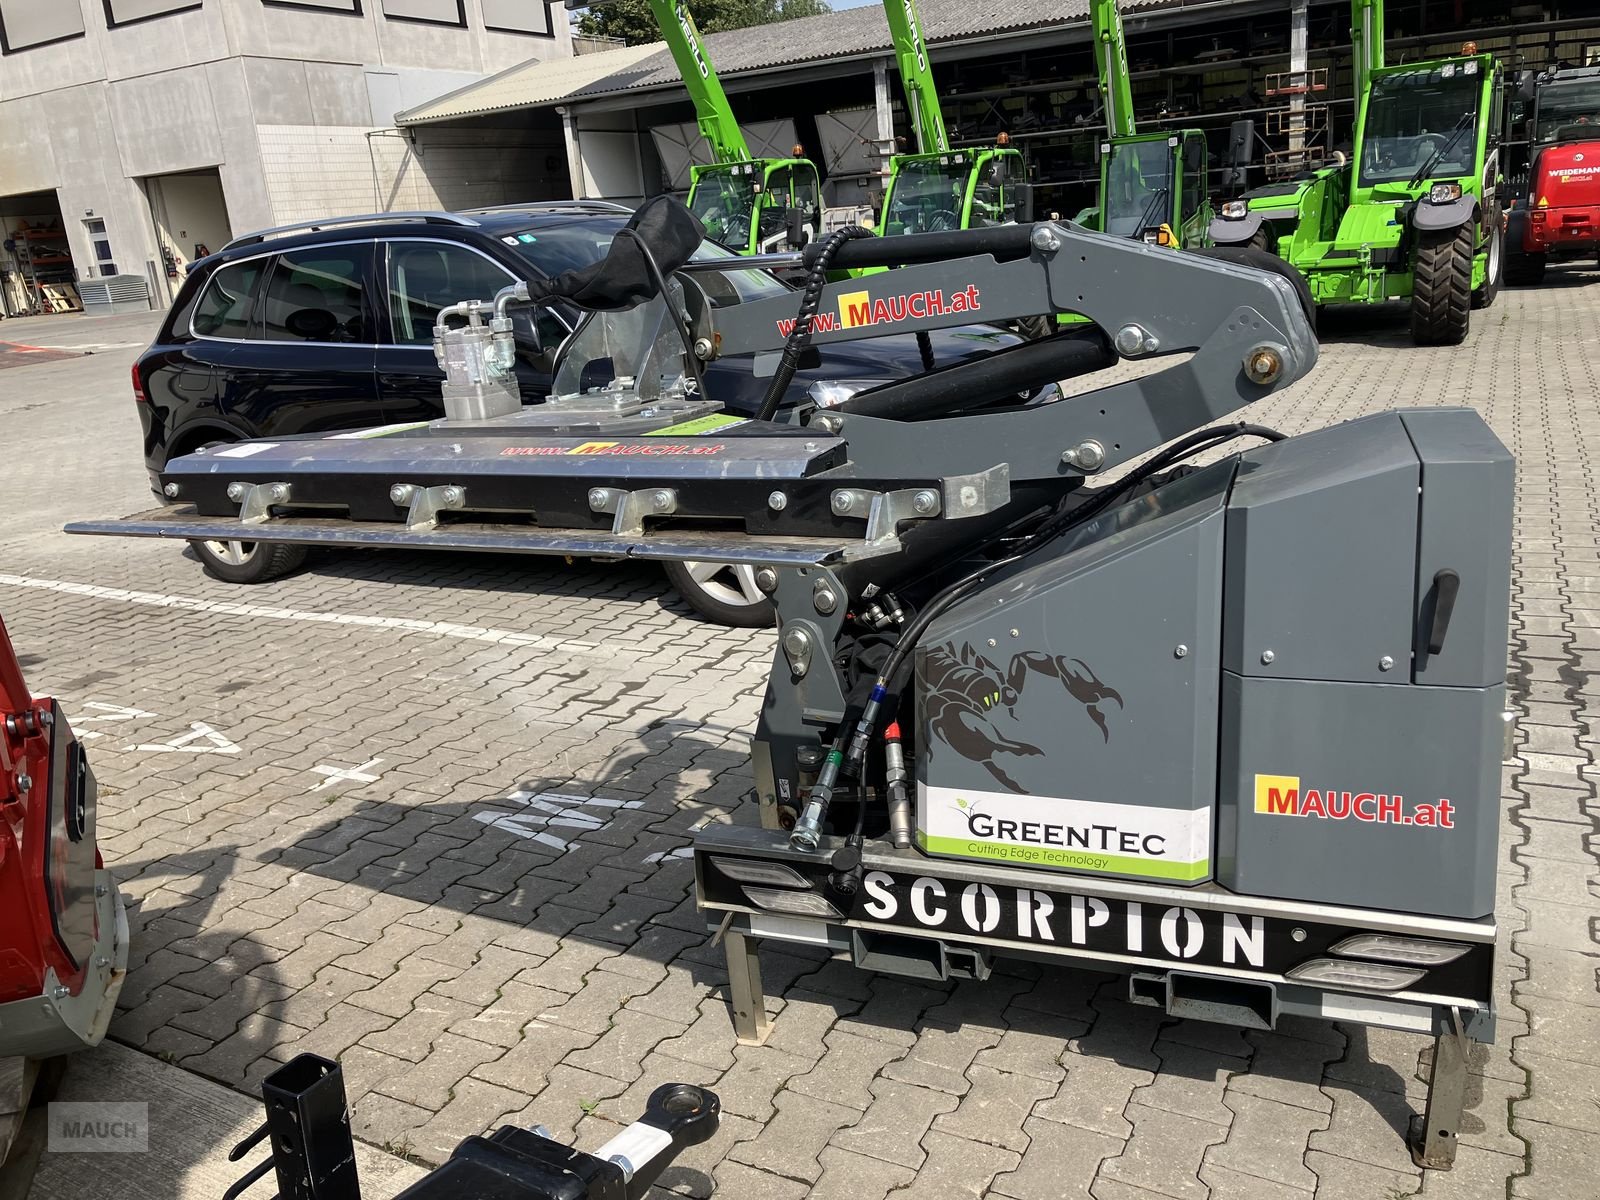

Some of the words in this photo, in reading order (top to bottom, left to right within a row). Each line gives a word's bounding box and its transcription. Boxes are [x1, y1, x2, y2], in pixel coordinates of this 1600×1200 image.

[675, 5, 709, 79] MERLO
[500, 443, 724, 456] www.MAUCH.at
[1265, 786, 1455, 829] MAUCH.at
[967, 843, 1008, 858] Cutting
[1010, 847, 1040, 860] Edge
[1042, 850, 1109, 869] Technology
[863, 870, 1265, 968] SCORPION
